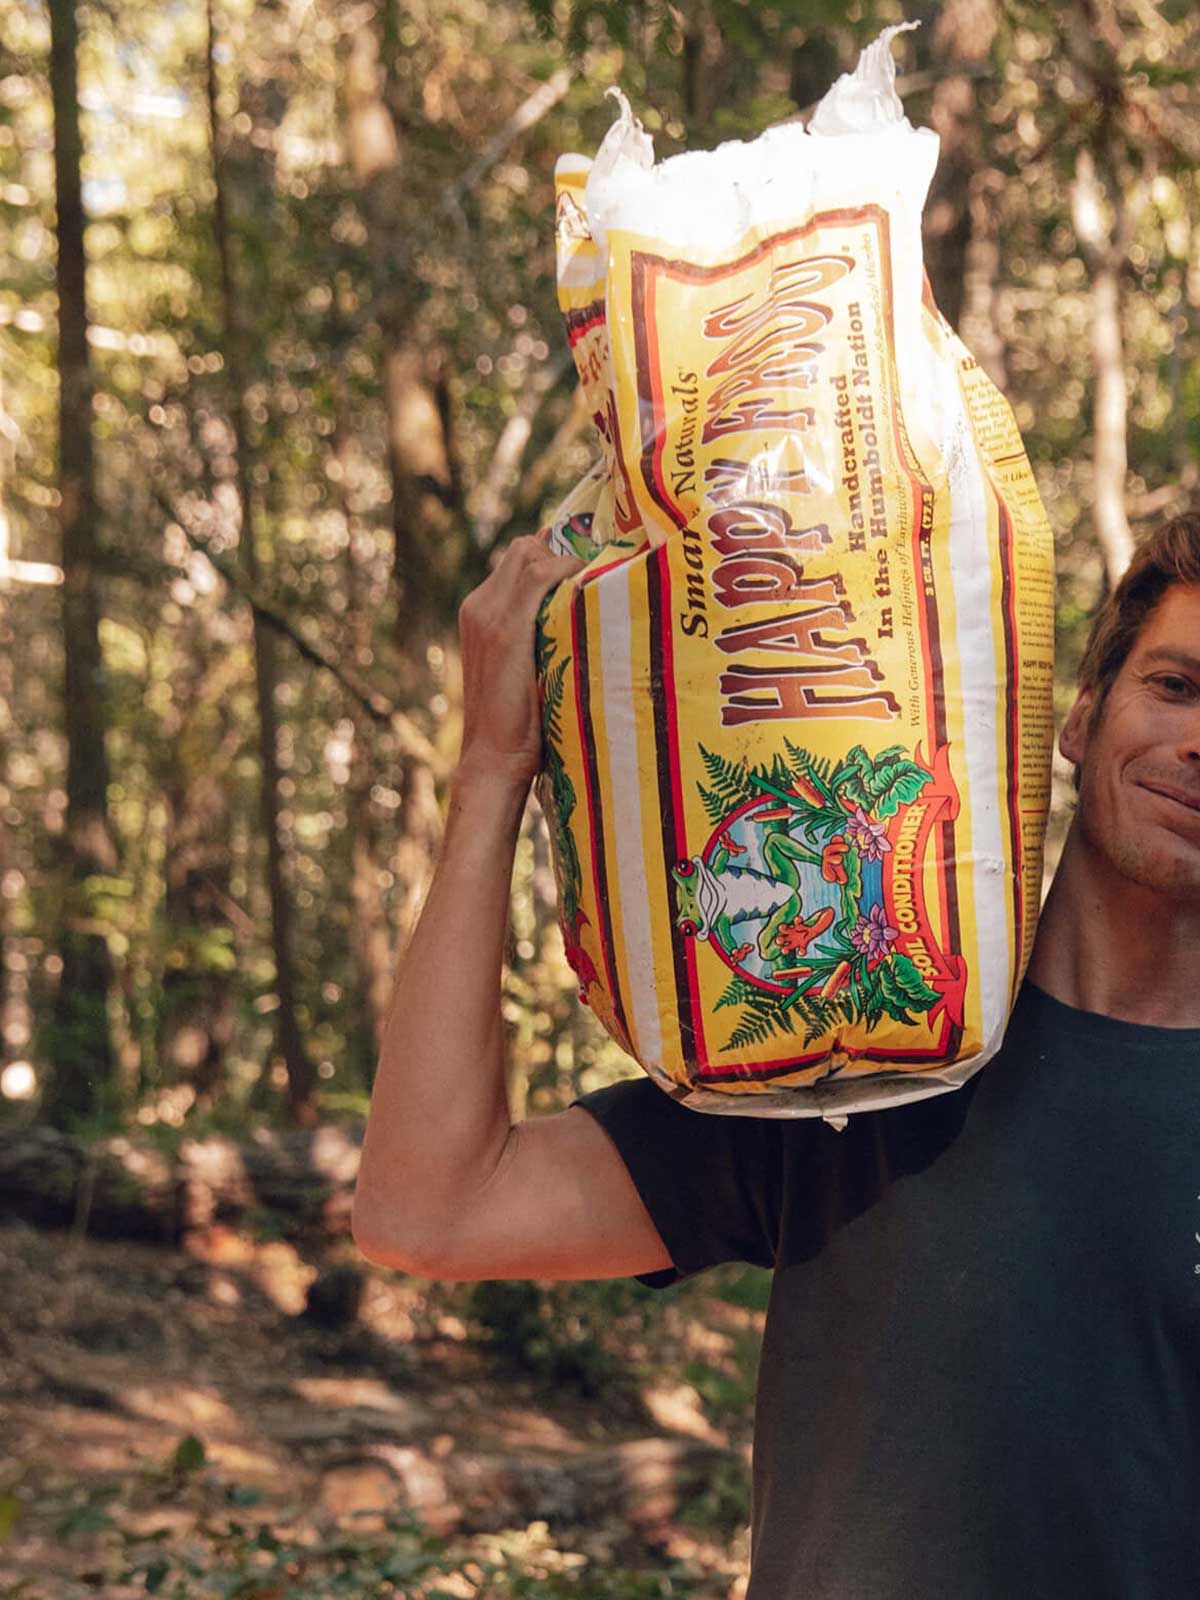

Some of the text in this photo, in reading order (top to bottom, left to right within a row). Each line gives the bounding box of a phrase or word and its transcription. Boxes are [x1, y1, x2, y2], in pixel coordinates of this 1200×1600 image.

[847, 302, 870, 386] Nation
[671, 371, 698, 498] Naturals
[830, 375, 867, 552] Handcrafted
[854, 396, 889, 540] Humboldt
[702, 255, 900, 728] HAPPY FROG
[874, 548, 891, 599] the
[896, 546, 908, 566] of
[877, 606, 894, 640] In
[901, 570, 914, 627] Helpings
[905, 631, 919, 690] Generous
[910, 695, 921, 727] With
[892, 803, 940, 978] SOIL CONDITIONER
